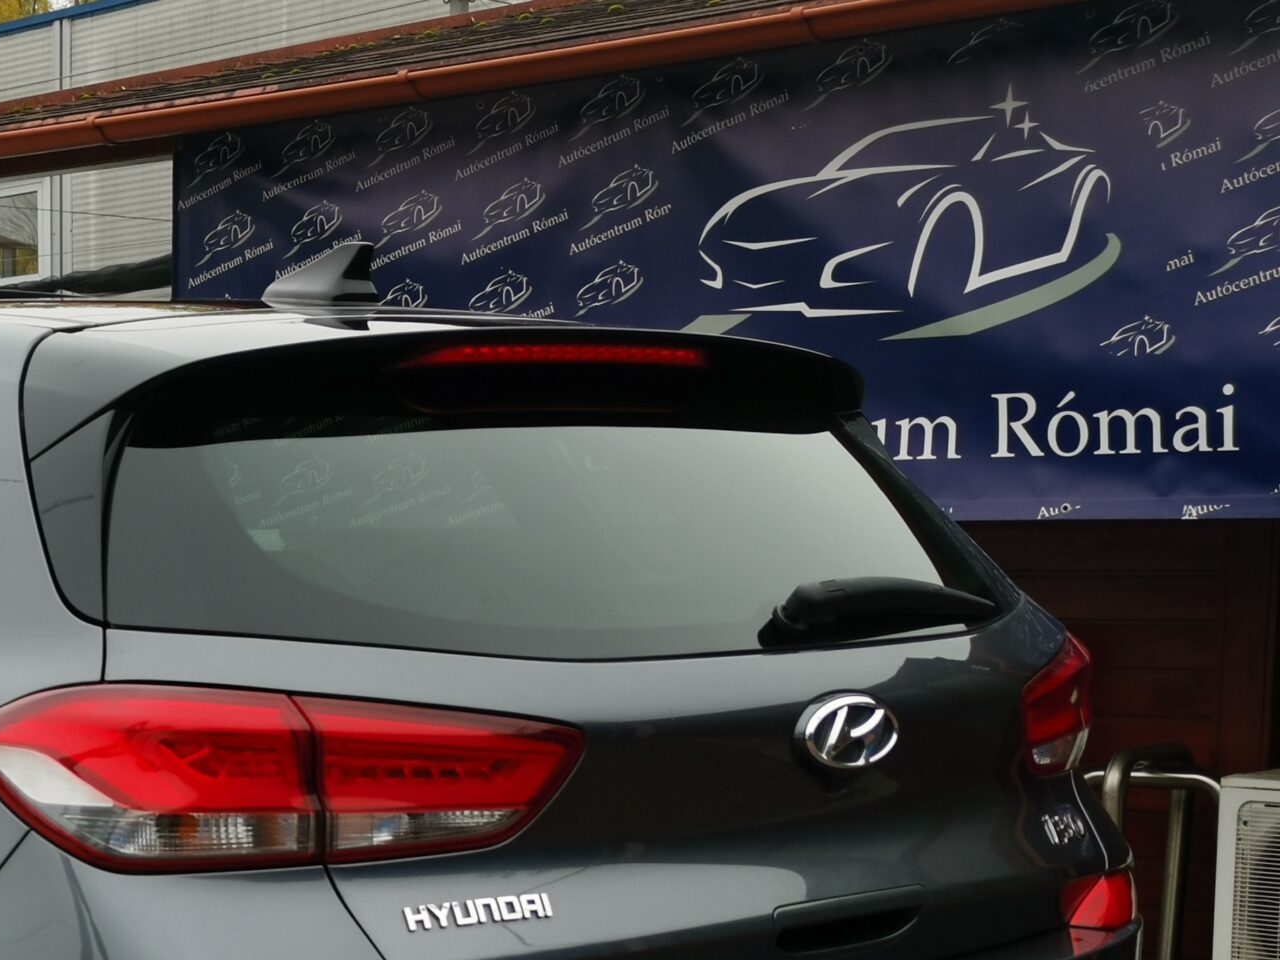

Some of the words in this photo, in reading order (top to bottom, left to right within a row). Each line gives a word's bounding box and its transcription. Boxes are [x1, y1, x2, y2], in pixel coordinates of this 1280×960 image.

[1160, 31, 1212, 63] Római
[557, 124, 631, 168] Autócentrum
[633, 105, 670, 132] Római
[671, 109, 747, 155] Autócentrum
[749, 88, 790, 118] Római
[262, 166, 324, 202] Autócentrum
[325, 150, 357, 173] Római
[355, 153, 421, 192] Autócentrum
[422, 136, 456, 159] Római
[454, 141, 523, 181] Autócentrum
[524, 121, 559, 147] Római
[1170, 137, 1222, 167] Római
[177, 177, 232, 211] Autócentrum
[232, 159, 263, 184] Római
[369, 239, 426, 271] utócentrum
[427, 220, 462, 243] Római
[461, 229, 530, 265] Autócentrum
[531, 209, 569, 236] Római
[569, 216, 643, 256] Autócentrum
[187, 255, 243, 289] Autócentrum
[244, 237, 274, 263] Római
[990, 383, 1240, 458] Római
[402, 892, 554, 932] HYUNDAI
